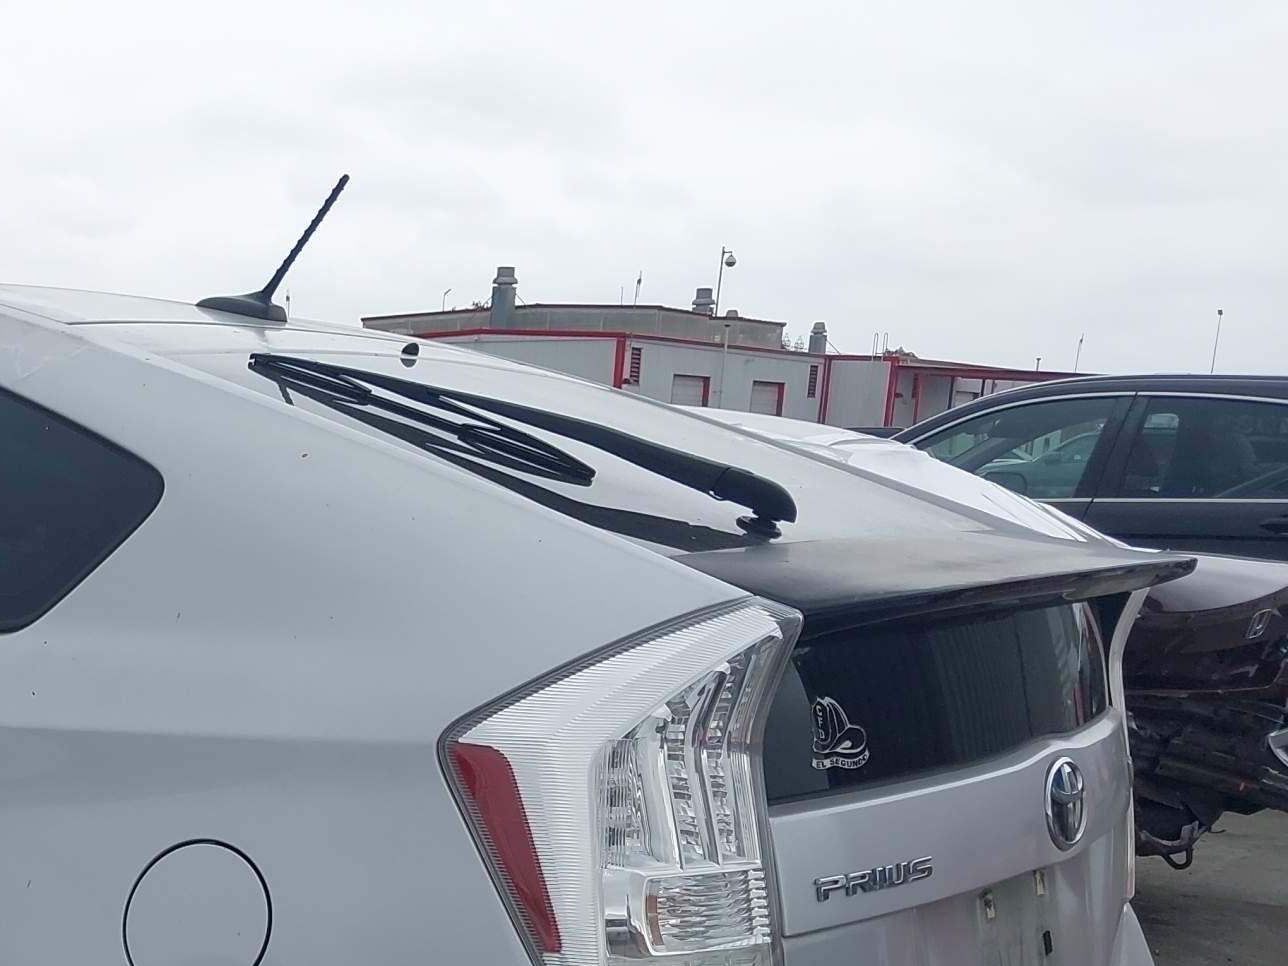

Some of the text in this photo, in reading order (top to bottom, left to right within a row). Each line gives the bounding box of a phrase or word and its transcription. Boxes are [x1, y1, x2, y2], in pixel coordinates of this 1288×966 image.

[815, 754, 868, 769] EL SEGUNDO
[814, 855, 933, 903] PRIUS
